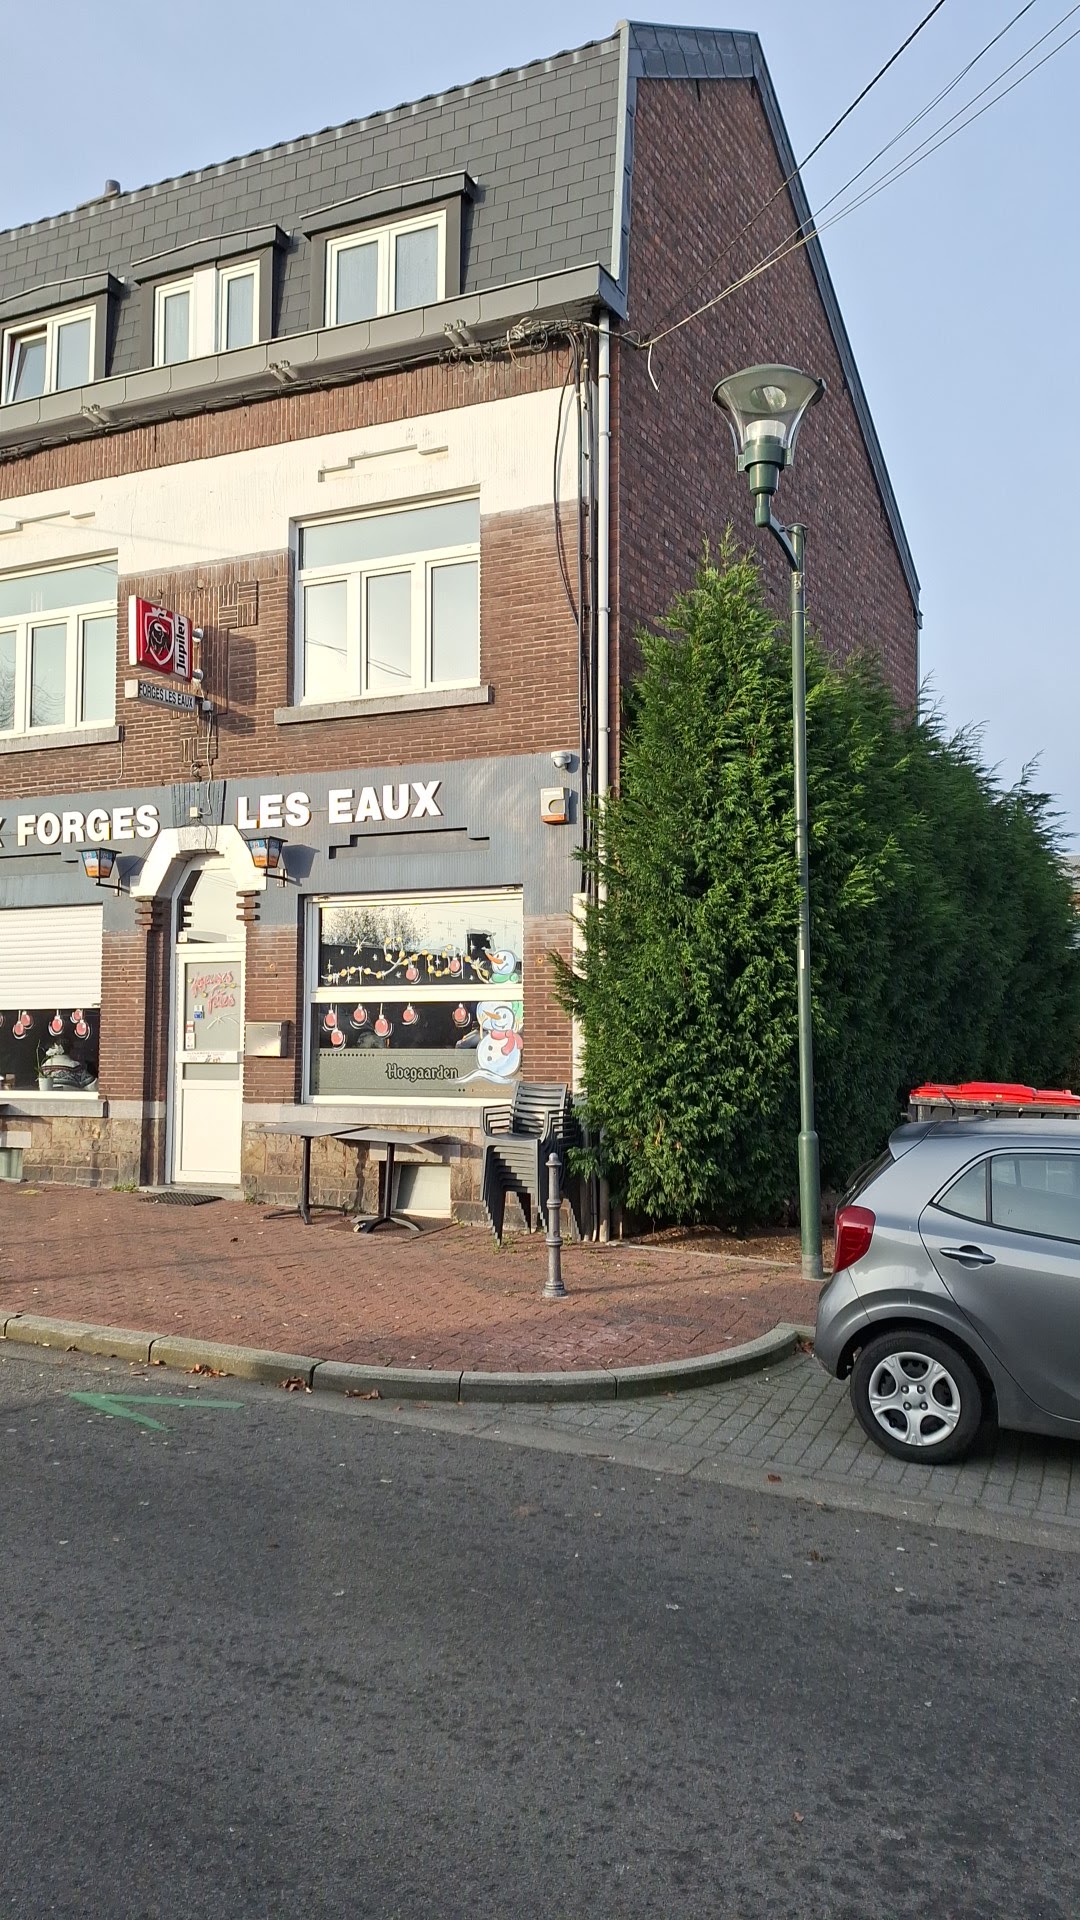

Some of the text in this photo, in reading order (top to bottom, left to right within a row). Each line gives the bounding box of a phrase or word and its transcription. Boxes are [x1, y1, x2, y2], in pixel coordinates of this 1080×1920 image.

[176, 616, 188, 674] Jupiler
[139, 683, 193, 708] FORGES LES EAUX
[17, 804, 160, 847] FORGES
[237, 791, 311, 830] LES
[328, 780, 442, 824] EAUX
[386, 1063, 459, 1082] Hoegaarden
